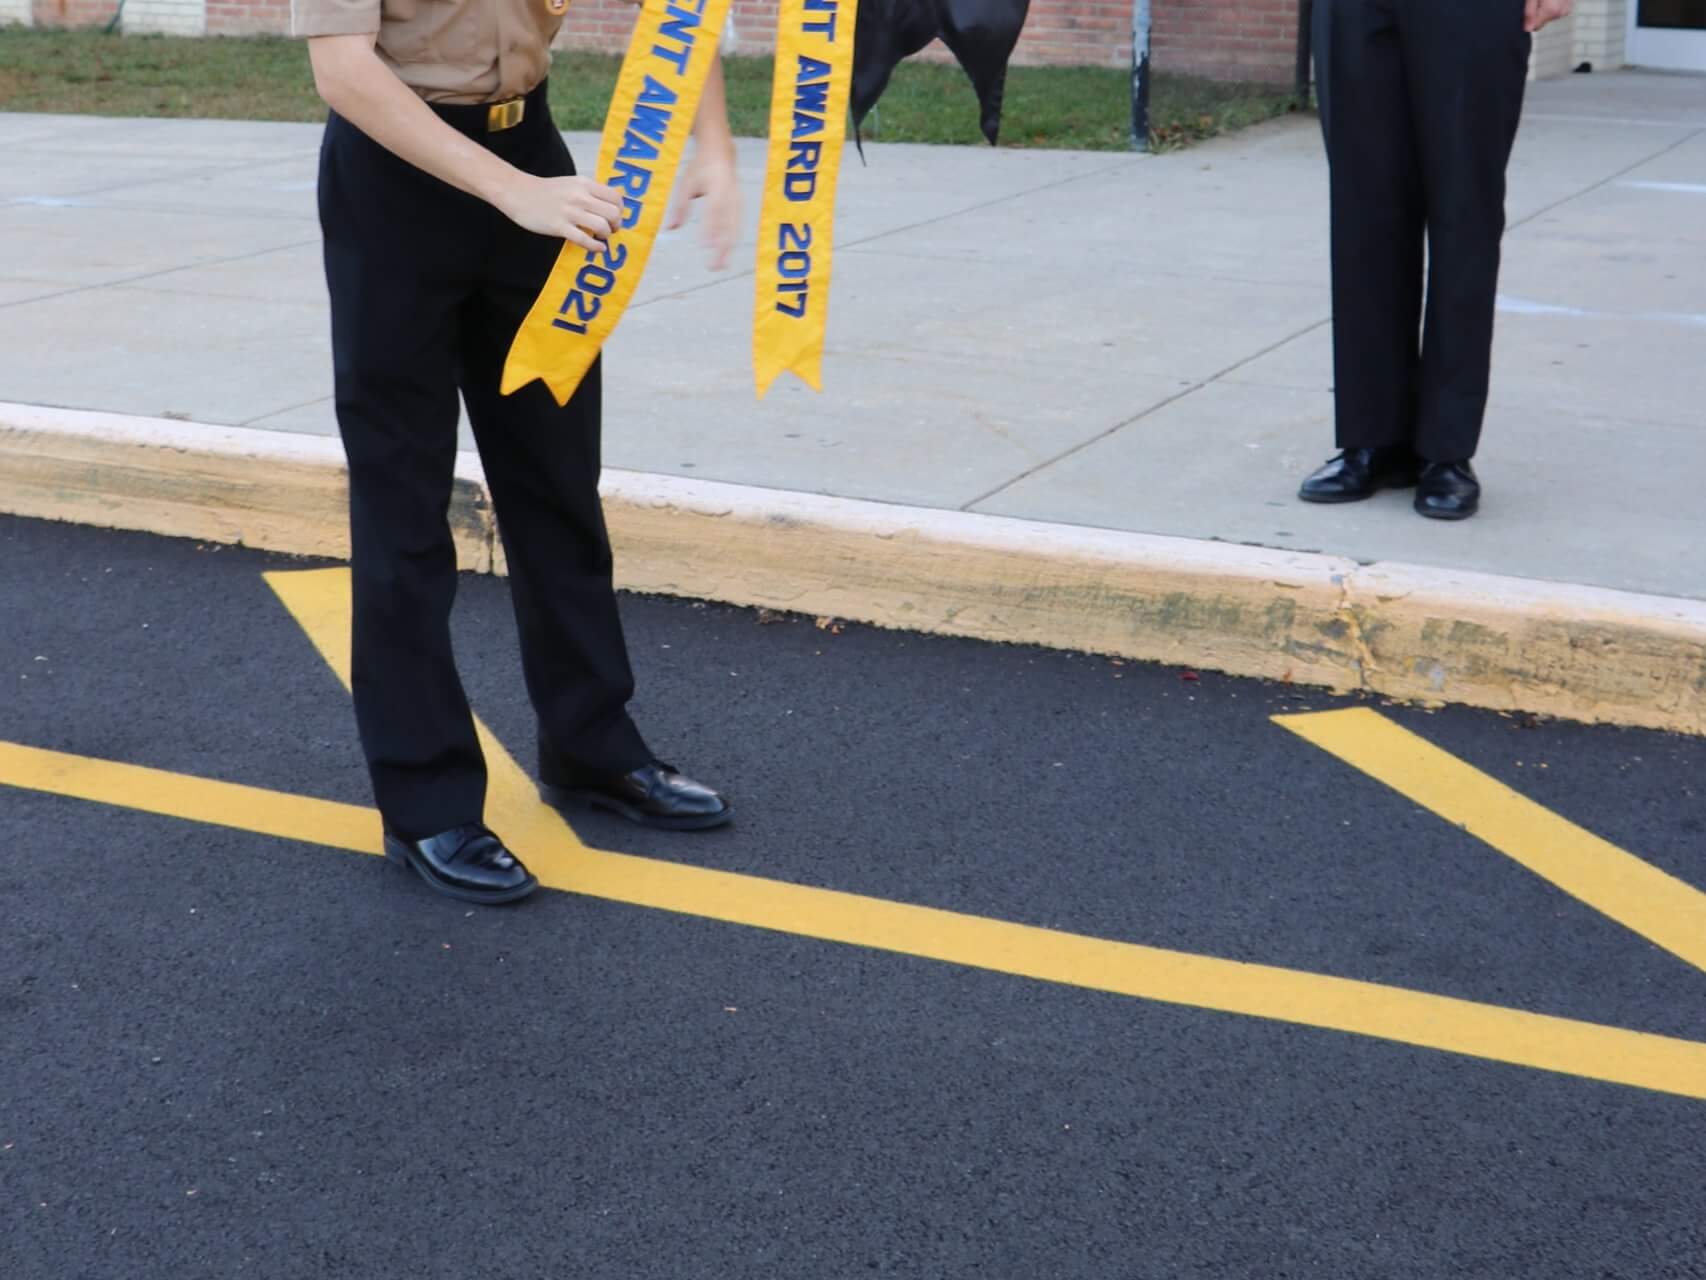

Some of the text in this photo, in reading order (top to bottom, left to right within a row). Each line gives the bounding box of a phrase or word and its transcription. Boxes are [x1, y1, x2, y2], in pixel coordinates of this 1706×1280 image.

[783, 54, 832, 203] AWARD
[551, 238, 628, 335] 2021
[775, 222, 812, 319] 2017
